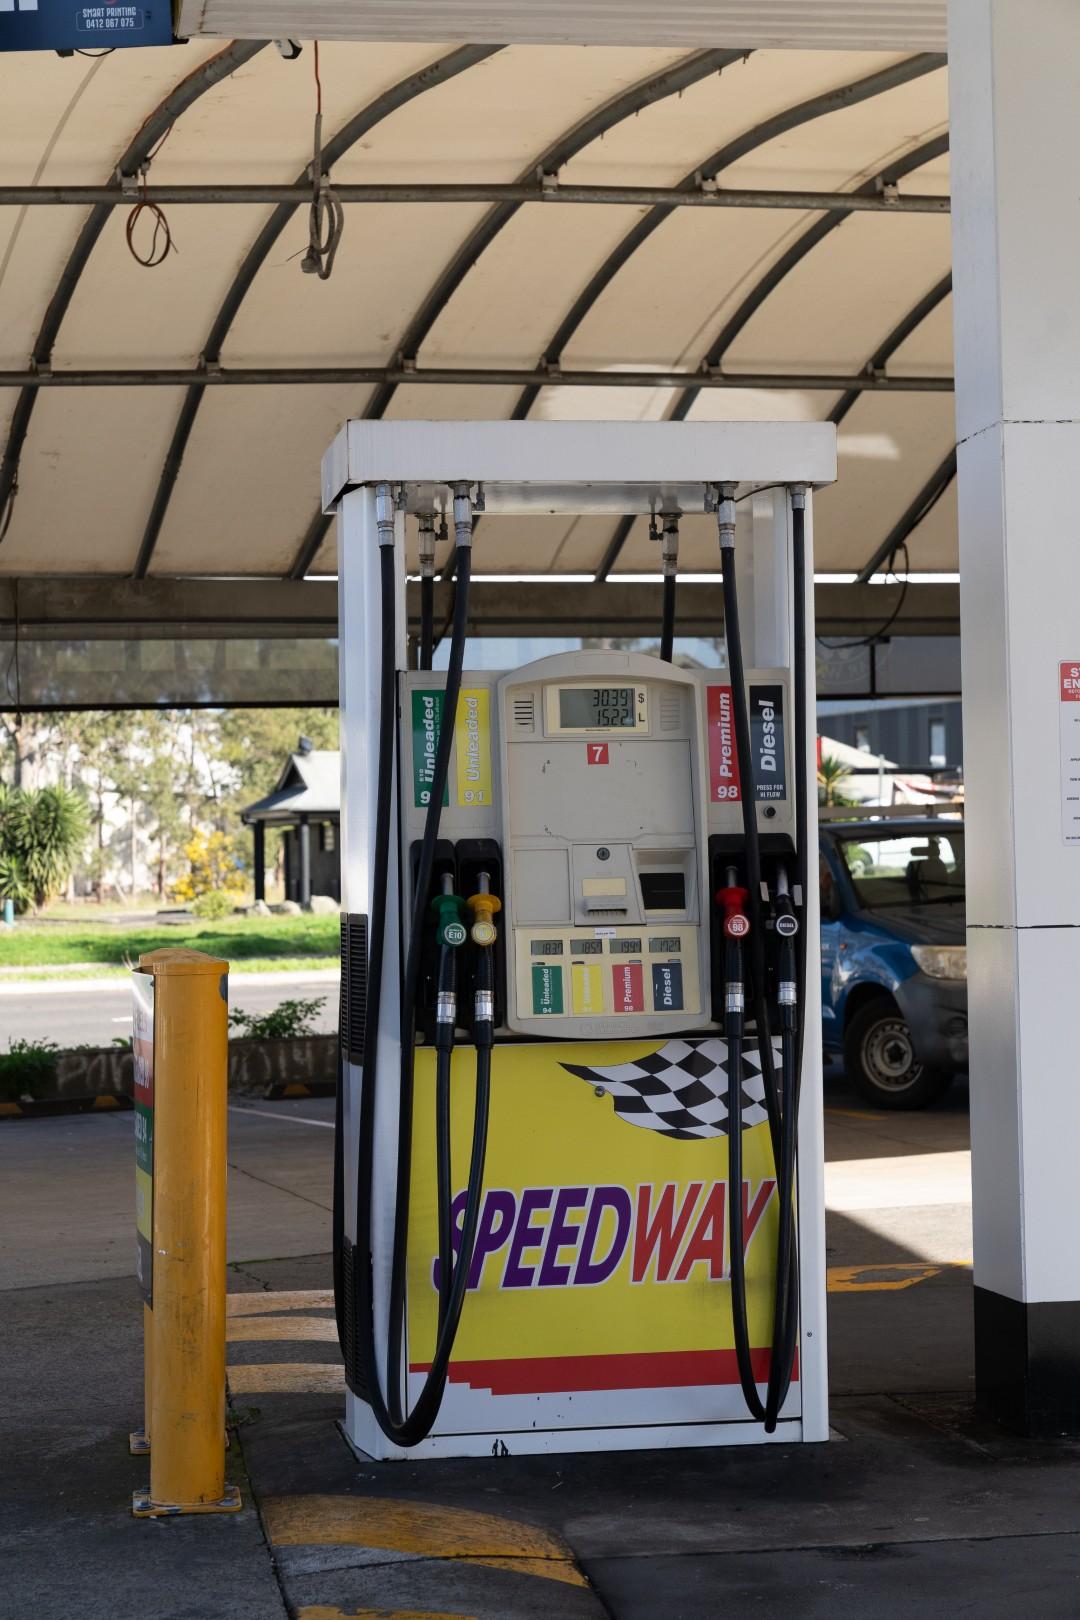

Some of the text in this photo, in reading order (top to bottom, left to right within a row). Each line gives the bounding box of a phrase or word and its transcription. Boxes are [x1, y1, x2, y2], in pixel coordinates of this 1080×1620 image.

[82, 6, 137, 18] SMART PRINTING
[86, 18, 104, 29] 0412
[638, 692, 645, 704] $
[638, 712, 645, 722] L
[422, 696, 436, 783] Unleaded
[464, 696, 481, 782] Unleaded
[717, 693, 733, 778] Premium
[758, 700, 777, 772] Diesel
[592, 746, 604, 762] 7
[420, 790, 431, 804] 9
[717, 785, 739, 799] 98
[448, 931, 462, 939] E10
[541, 968, 550, 1005] Unleaded
[623, 966, 633, 1003] Premium
[661, 967, 673, 1006] Diesel
[431, 1179, 777, 1291] SPEEDWAY
